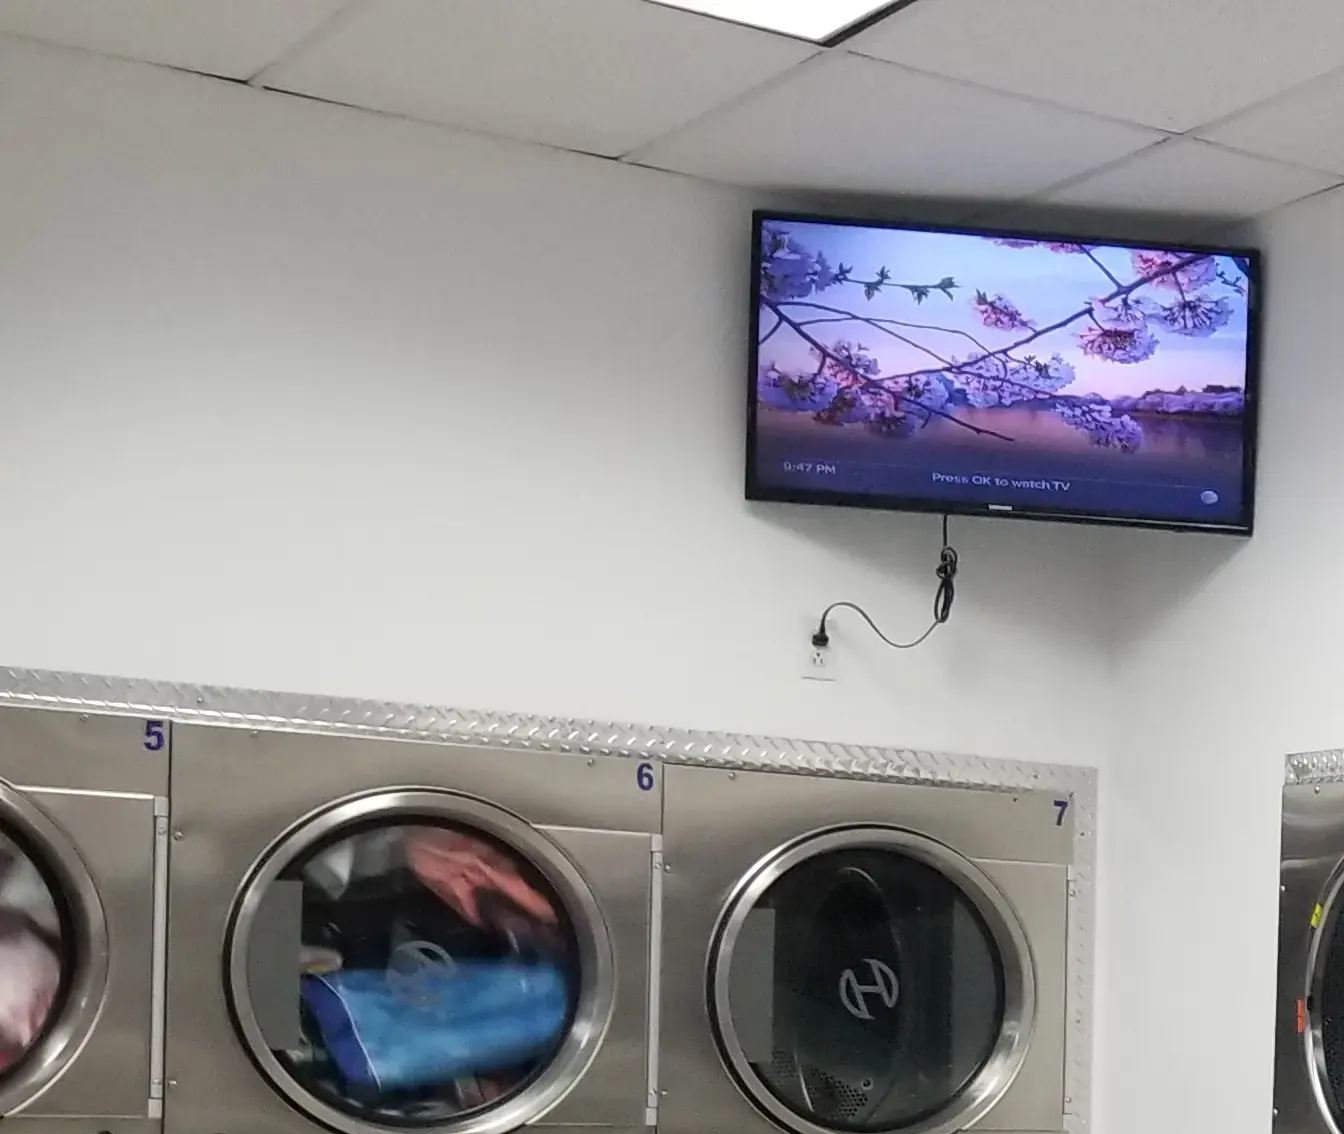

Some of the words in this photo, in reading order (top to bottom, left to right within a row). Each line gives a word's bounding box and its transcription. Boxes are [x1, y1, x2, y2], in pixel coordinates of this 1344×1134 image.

[816, 463, 836, 475] PM
[932, 472, 969, 484] Press
[971, 475, 991, 486] OK
[994, 477, 1009, 487] to
[1011, 480, 1050, 490] watch
[1052, 481, 1071, 491] TV
[143, 722, 165, 751] 5
[636, 763, 654, 791] 6
[1052, 800, 1068, 827] 7
